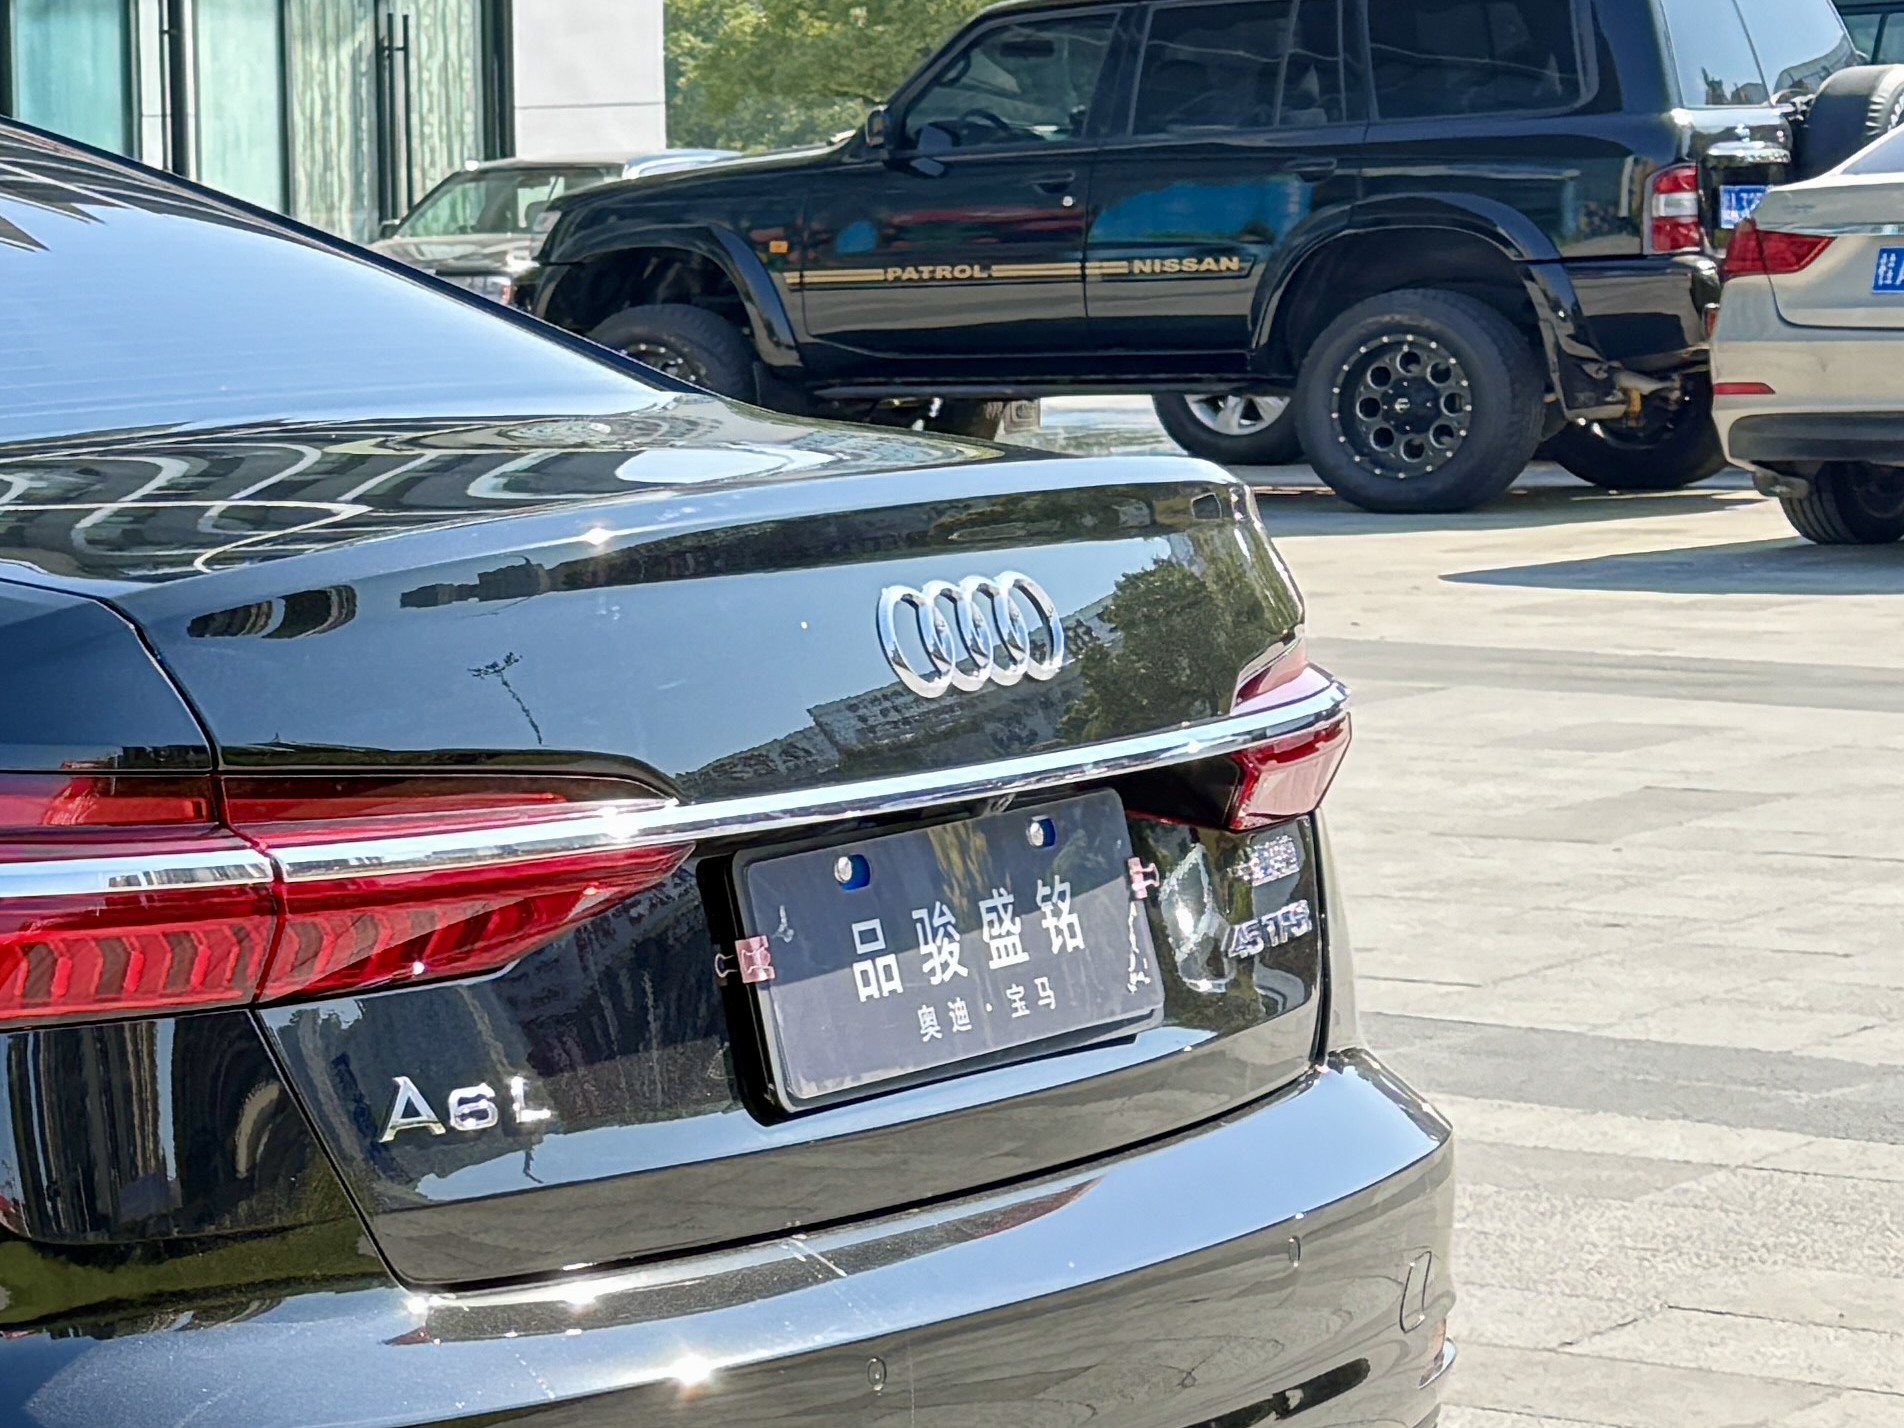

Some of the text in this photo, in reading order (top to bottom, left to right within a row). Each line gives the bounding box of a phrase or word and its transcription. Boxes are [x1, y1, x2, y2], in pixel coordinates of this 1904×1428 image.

[886, 263, 989, 282] PATROL
[1132, 256, 1240, 274] NISSAN
[851, 874, 1085, 1002] 品骏盛铭
